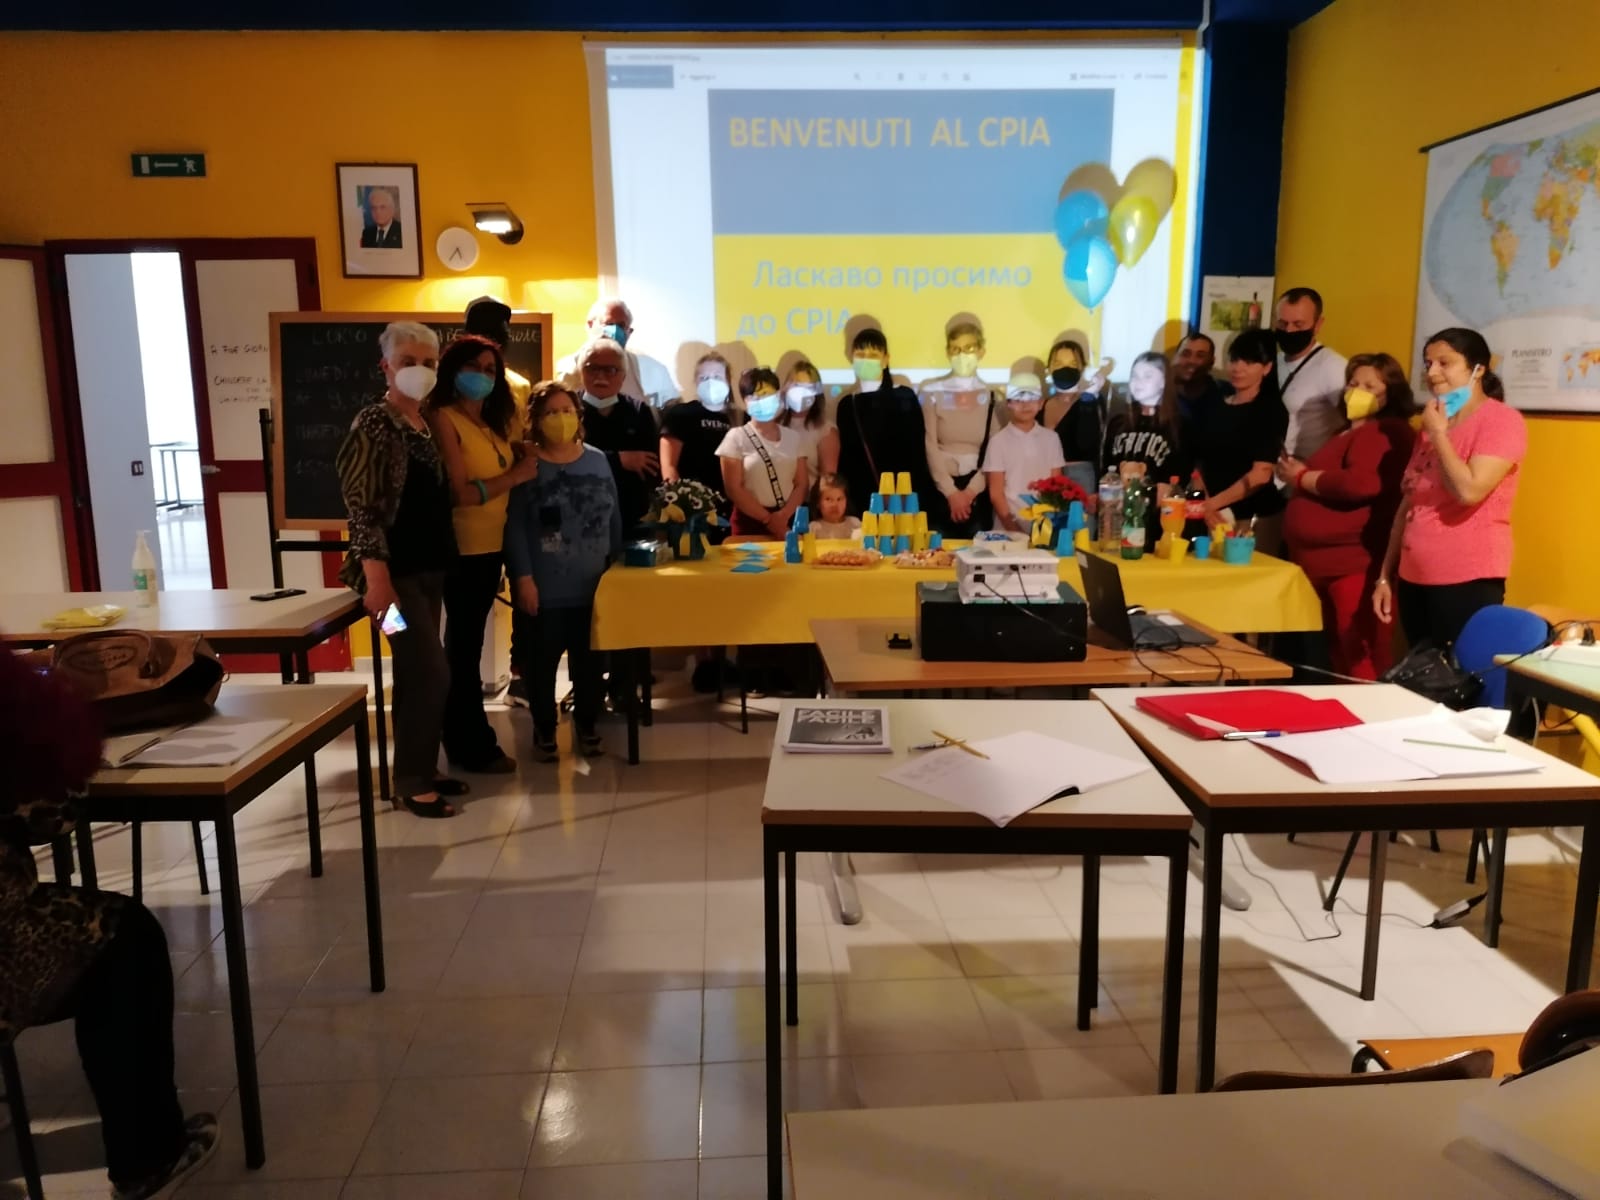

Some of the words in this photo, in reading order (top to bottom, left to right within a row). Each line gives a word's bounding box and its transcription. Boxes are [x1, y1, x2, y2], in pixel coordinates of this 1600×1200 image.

[730, 118, 911, 147] BENVENUTI
[931, 118, 968, 147] AL
[979, 118, 1051, 147] CPIA
[753, 260, 882, 288] Ласкаво
[893, 266, 1032, 293] просимо
[736, 314, 777, 339] до
